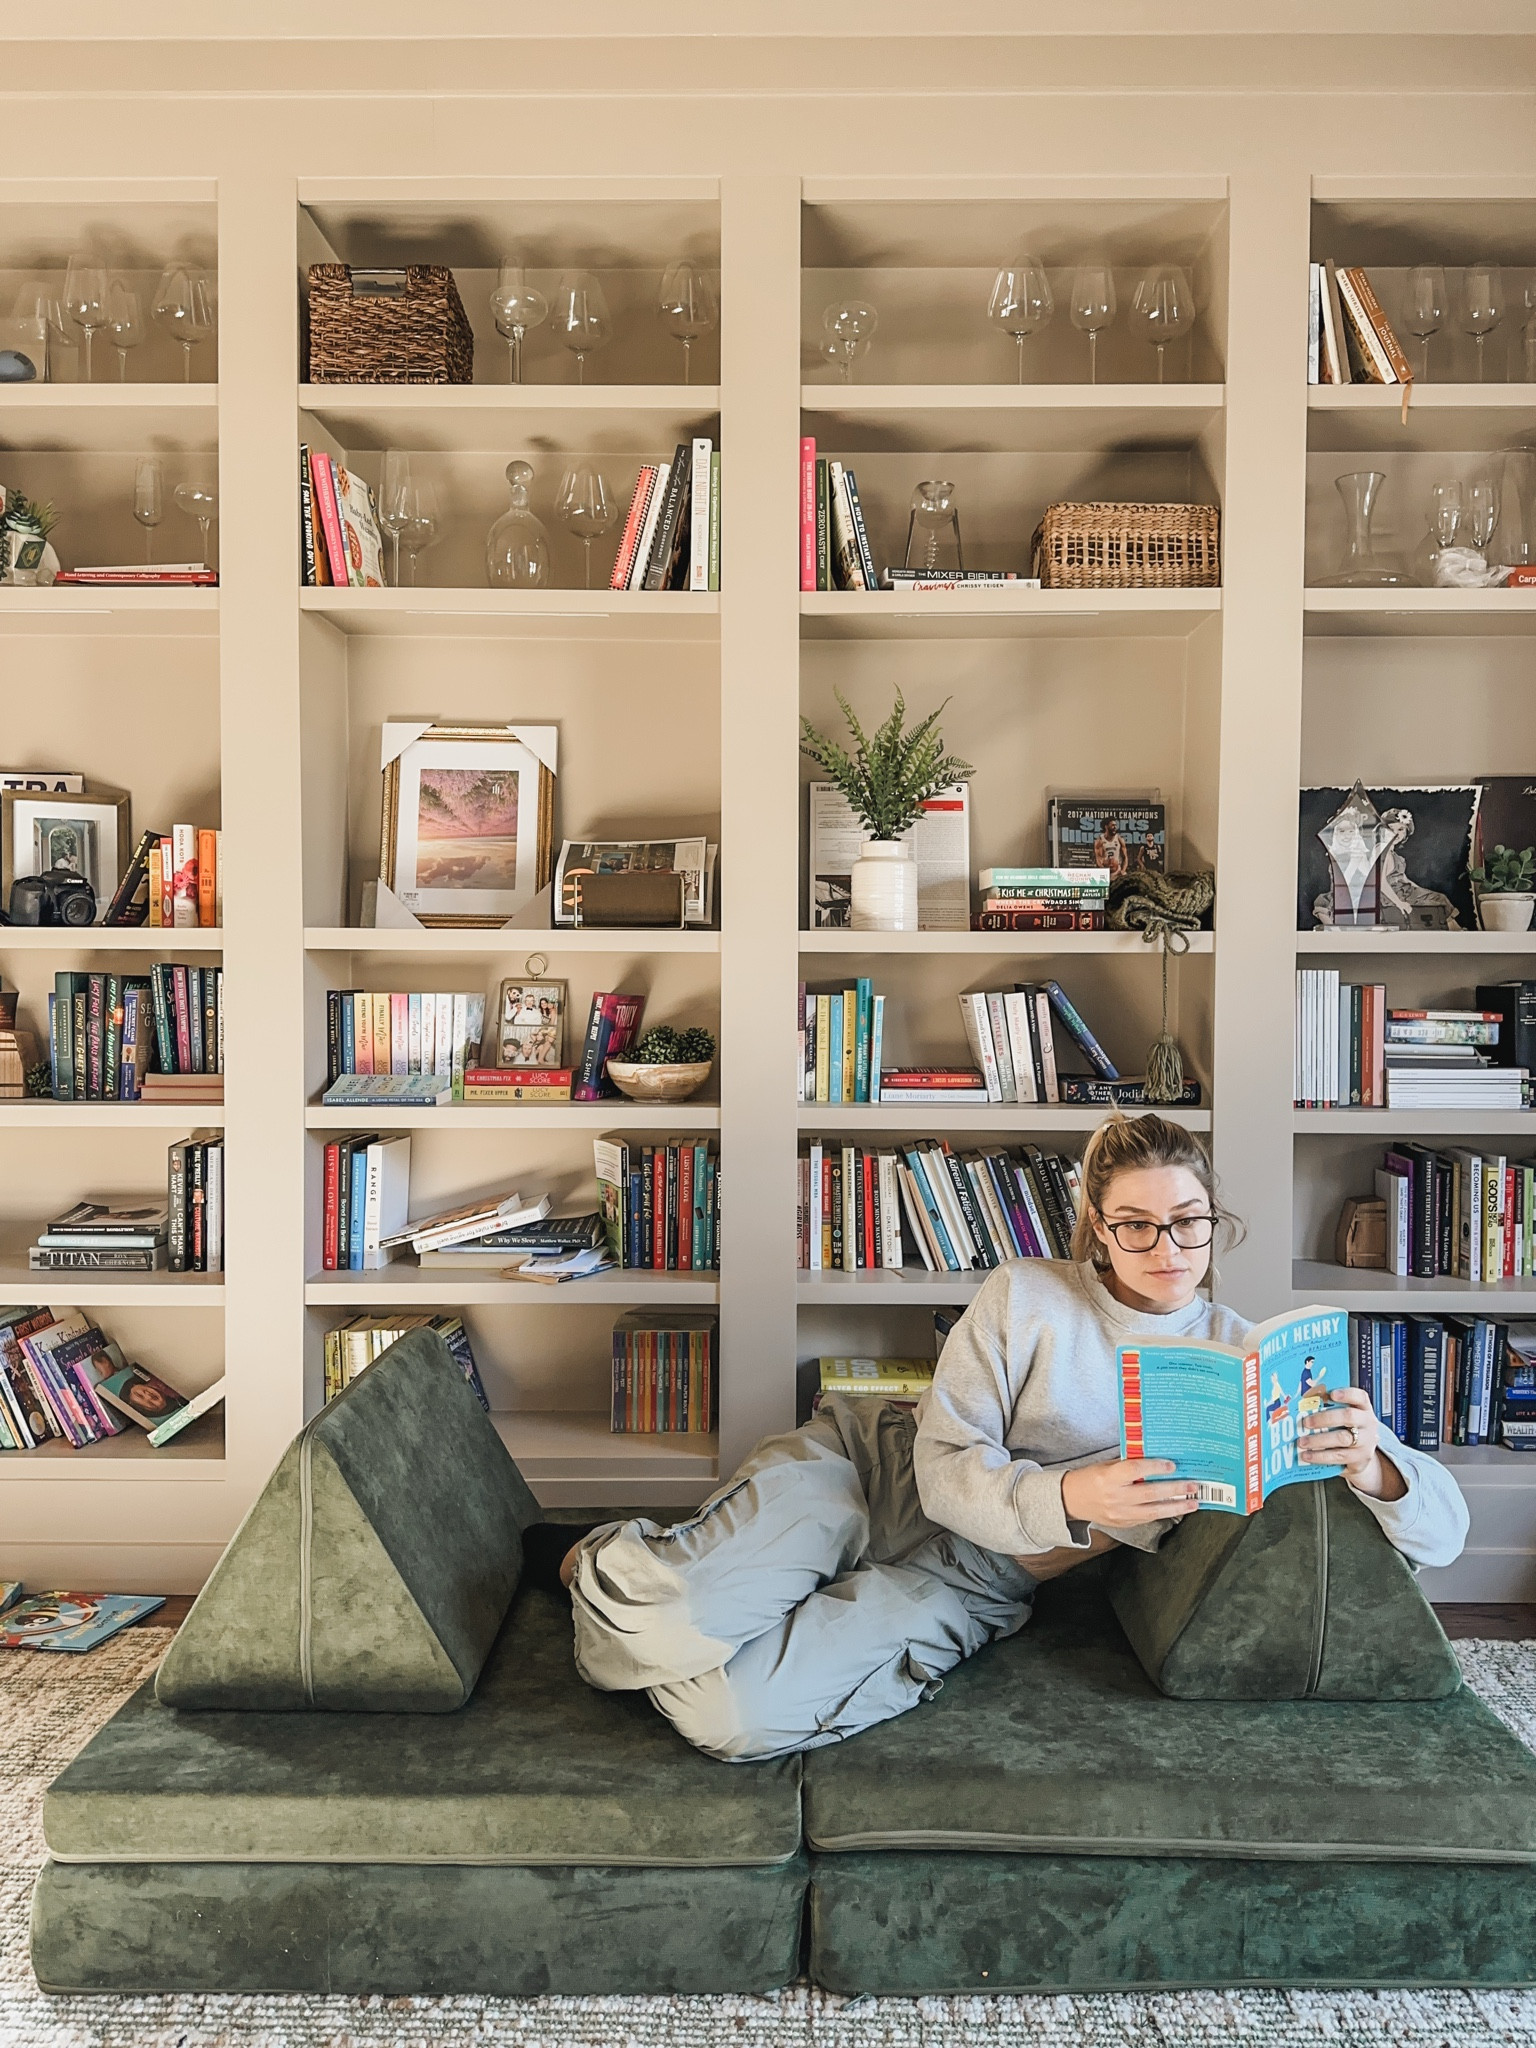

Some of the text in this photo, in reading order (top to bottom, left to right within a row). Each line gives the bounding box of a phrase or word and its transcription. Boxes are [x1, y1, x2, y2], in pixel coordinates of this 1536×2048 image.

[1341, 275, 1363, 319] MARIA SHRIVER
[1359, 273, 1378, 309] RYAN HOLIDAY
[1378, 327, 1398, 359] JOURNAL
[318, 460, 327, 478] REESE
[695, 459, 707, 515] DATE NIGHT IN
[320, 477, 333, 518] WITHERSPOON
[304, 506, 312, 518] THE
[663, 488, 678, 530] BALANCED
[855, 507, 863, 521] HOW
[845, 515, 853, 533] ELLA
[858, 524, 865, 533] TO
[305, 521, 314, 548] COOKING
[861, 535, 872, 559] INSTANT
[333, 551, 341, 570] TEACUP
[913, 580, 962, 590] Cravings
[927, 571, 963, 579] MIXER
[968, 572, 999, 580] BIBLE
[1519, 576, 1536, 585] Carp
[1119, 811, 1158, 819] CHAMPIONS
[1001, 888, 1015, 897] KISS
[1017, 889, 1026, 897] ME
[1035, 888, 1071, 897] CHRISTMAS
[91, 980, 100, 996] LUCY
[108, 979, 116, 993] LUCY
[76, 999, 84, 1012] LUCY
[91, 997, 100, 1016] FOLEY
[976, 1006, 984, 1034] Husband's
[993, 1016, 1001, 1037] LITTLE
[1014, 1017, 1022, 1034] Madly
[90, 1035, 100, 1055] PARIS
[107, 1032, 115, 1067] MIDNIGHT
[76, 1047, 84, 1074] GUEST
[586, 1050, 594, 1061] L.J.
[90, 1056, 99, 1091] APARTMENT
[583, 1063, 591, 1083] SHEN
[986, 1066, 994, 1091] MORIARTY
[999, 1059, 1007, 1089] MORIARTY
[904, 1092, 936, 1100] Moriarty
[1118, 1089, 1139, 1099] Jodi
[1035, 1157, 1052, 1194] ENDURE
[947, 1157, 965, 1190] Adrenal
[959, 1191, 976, 1221] Fatigue
[1488, 1179, 1498, 1212] GOD'S
[1023, 1190, 1036, 1215] mindset
[1473, 1204, 1479, 1214] US
[171, 1236, 177, 1245] UP
[498, 1237, 511, 1245] Why
[521, 1237, 537, 1245] Sleep
[46, 1252, 100, 1266] TITAN
[30, 1312, 52, 1328] WORDS
[57, 1326, 88, 1344] Kindness
[1263, 1316, 1340, 1361] MILY HENRY
[1473, 1341, 1481, 1378] IMMEDIATE
[1423, 1346, 1437, 1424] THE 4-HOUR BODY
[1244, 1359, 1259, 1494] BOOK LOVERS EMILY HENRY
